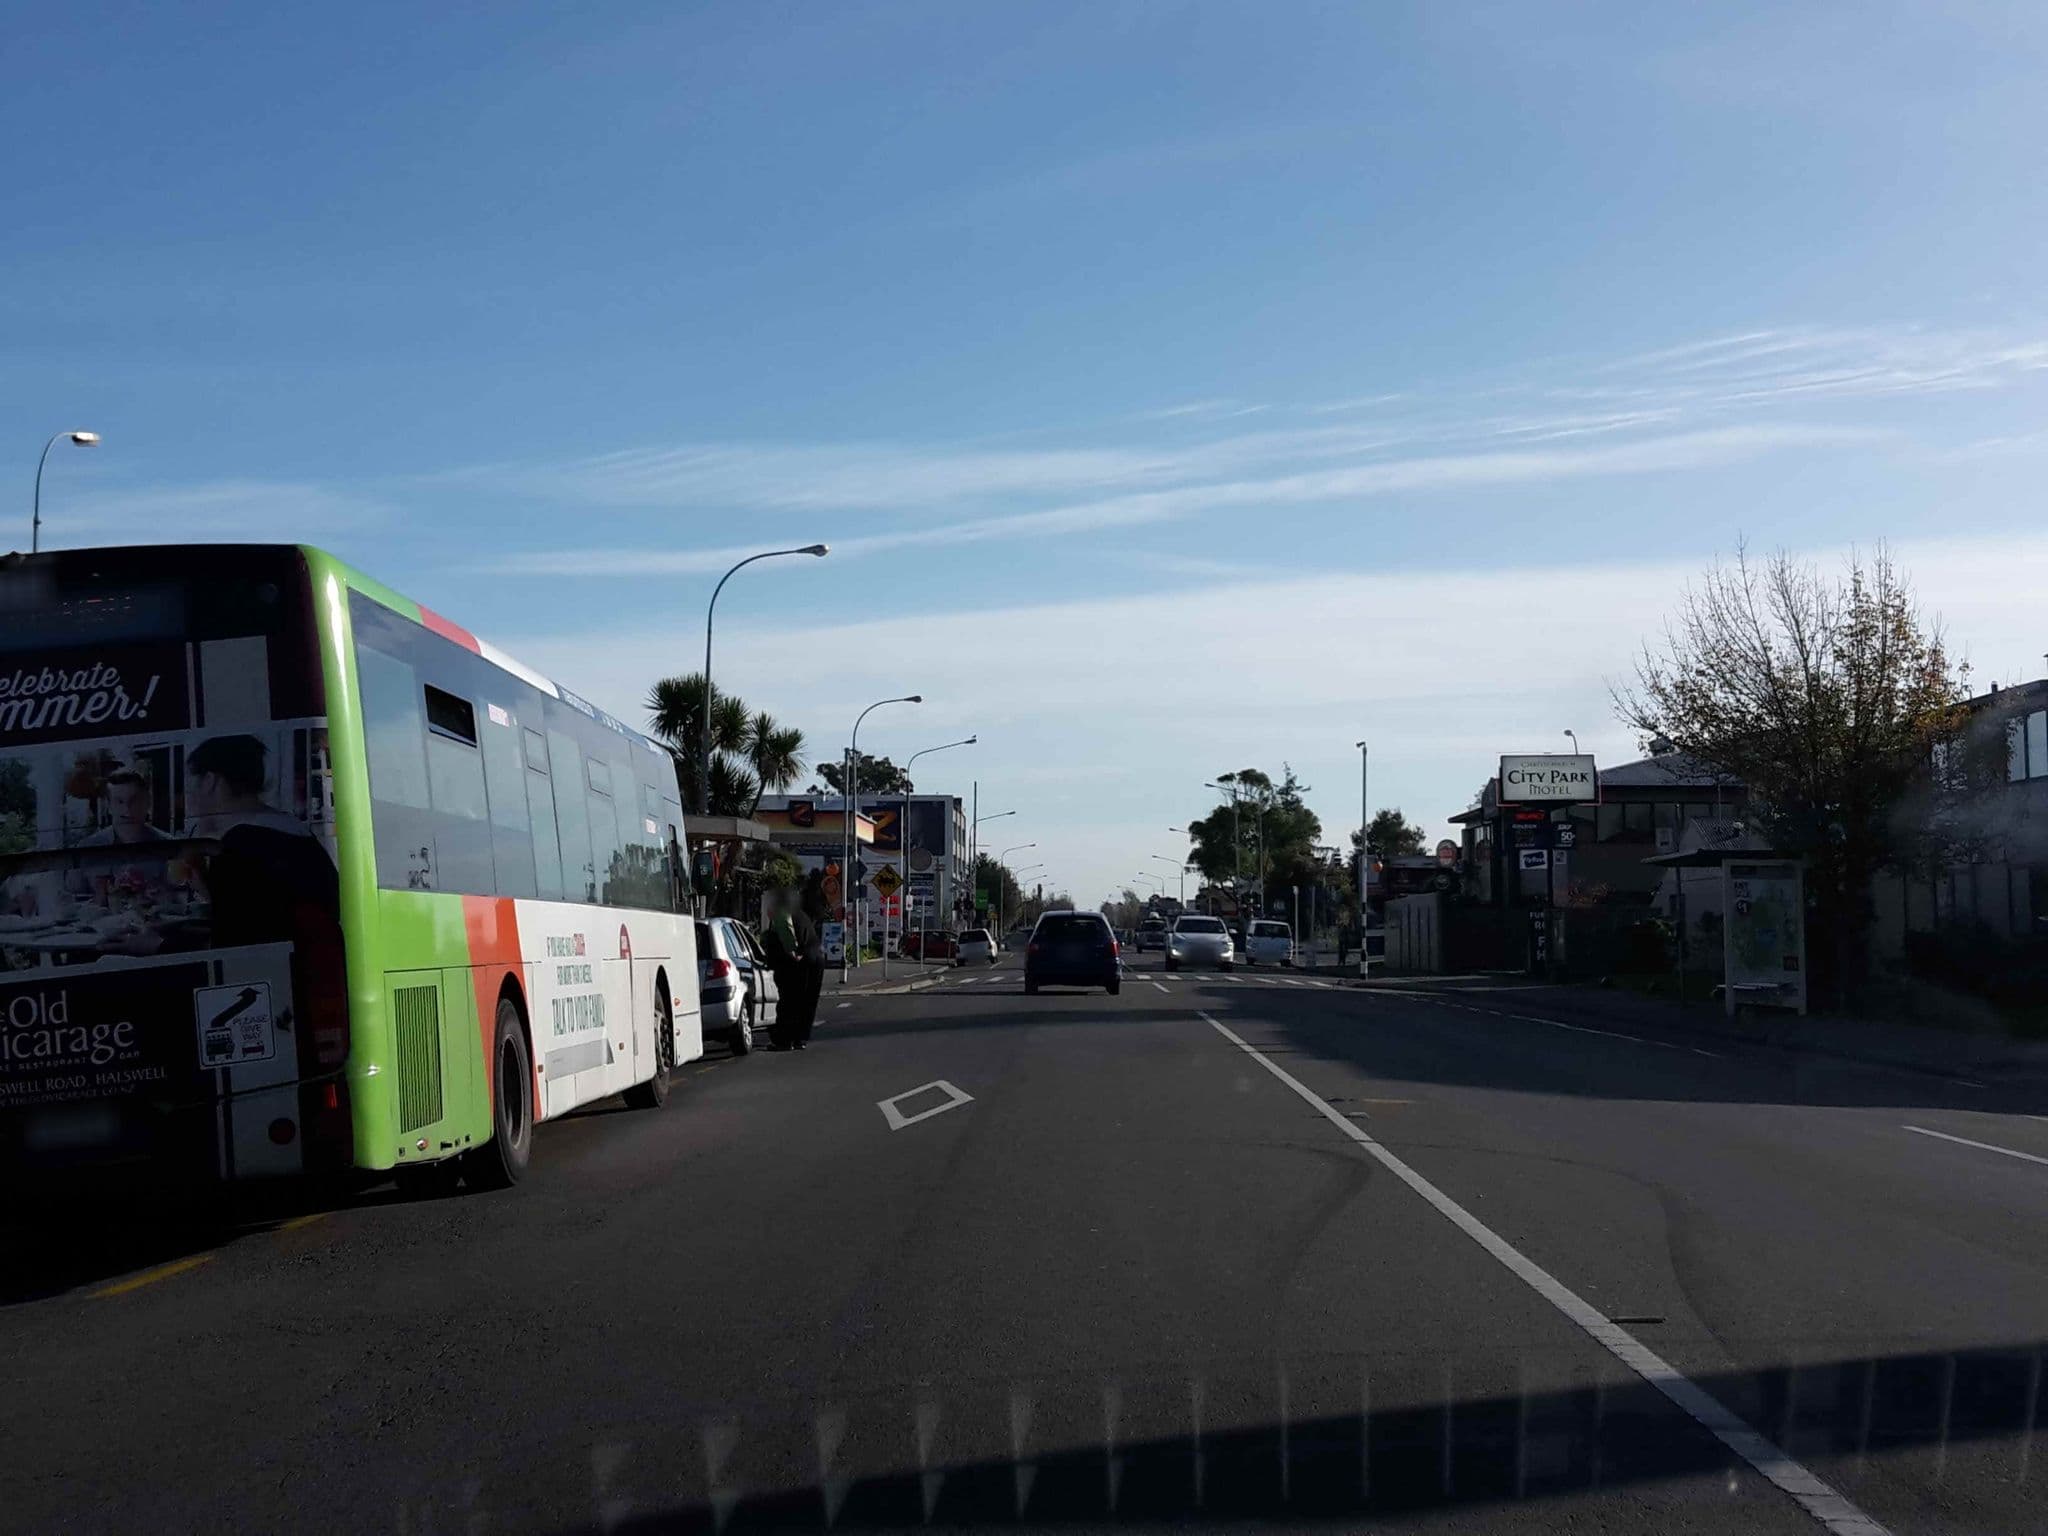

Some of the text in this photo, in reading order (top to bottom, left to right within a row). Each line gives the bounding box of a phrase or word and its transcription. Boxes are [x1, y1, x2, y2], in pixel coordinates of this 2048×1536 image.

[1551, 770, 1589, 784] PARK
[1529, 784, 1571, 795] MOTEL
[9, 990, 69, 1028] Old
[95, 1066, 168, 1085] HALSWELL
